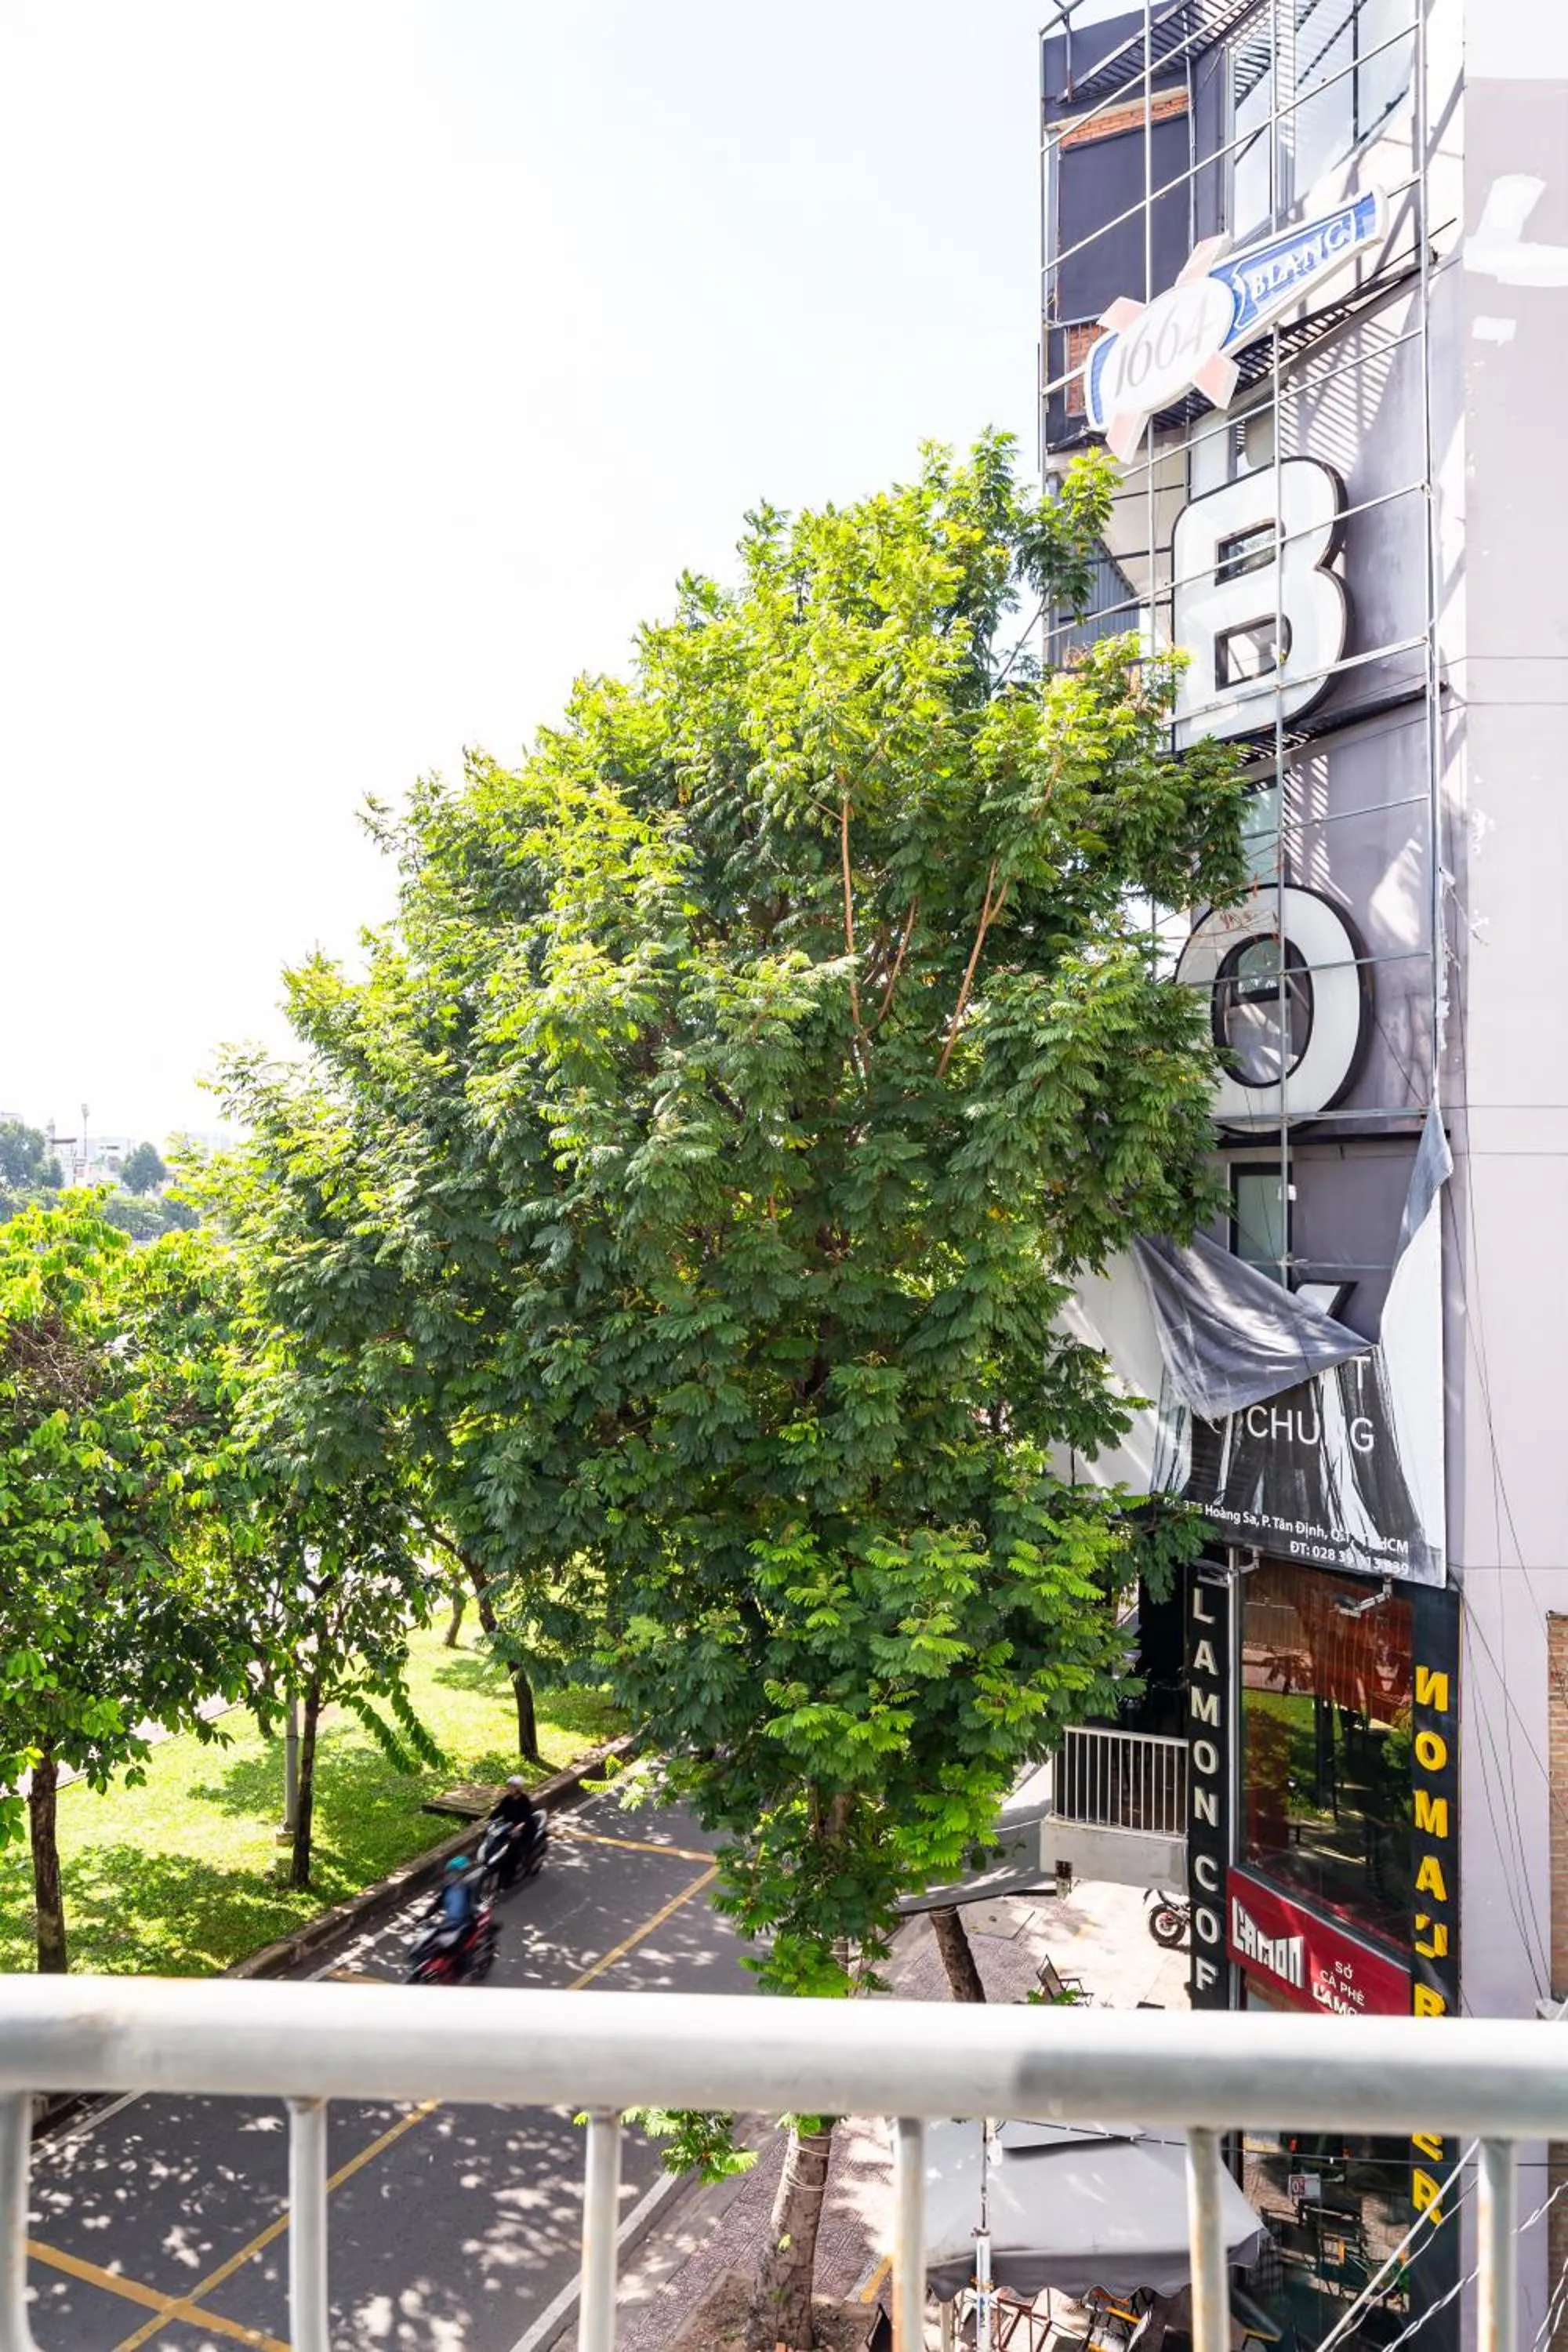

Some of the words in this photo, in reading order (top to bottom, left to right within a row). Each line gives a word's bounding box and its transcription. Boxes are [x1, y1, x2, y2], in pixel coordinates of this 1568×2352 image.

[1114, 290, 1216, 399] 1664
[1252, 220, 1350, 302] BLANC
[1247, 1405, 1374, 1451] CHUG
[1205, 1504, 1241, 1525] Hoàng
[1272, 1516, 1294, 1534] Tân
[1312, 1546, 1335, 1561] 028
[1191, 1587, 1220, 1828] LAMON
[1194, 1855, 1220, 1991] COF
[1312, 1981, 1360, 2017] L'AMO
